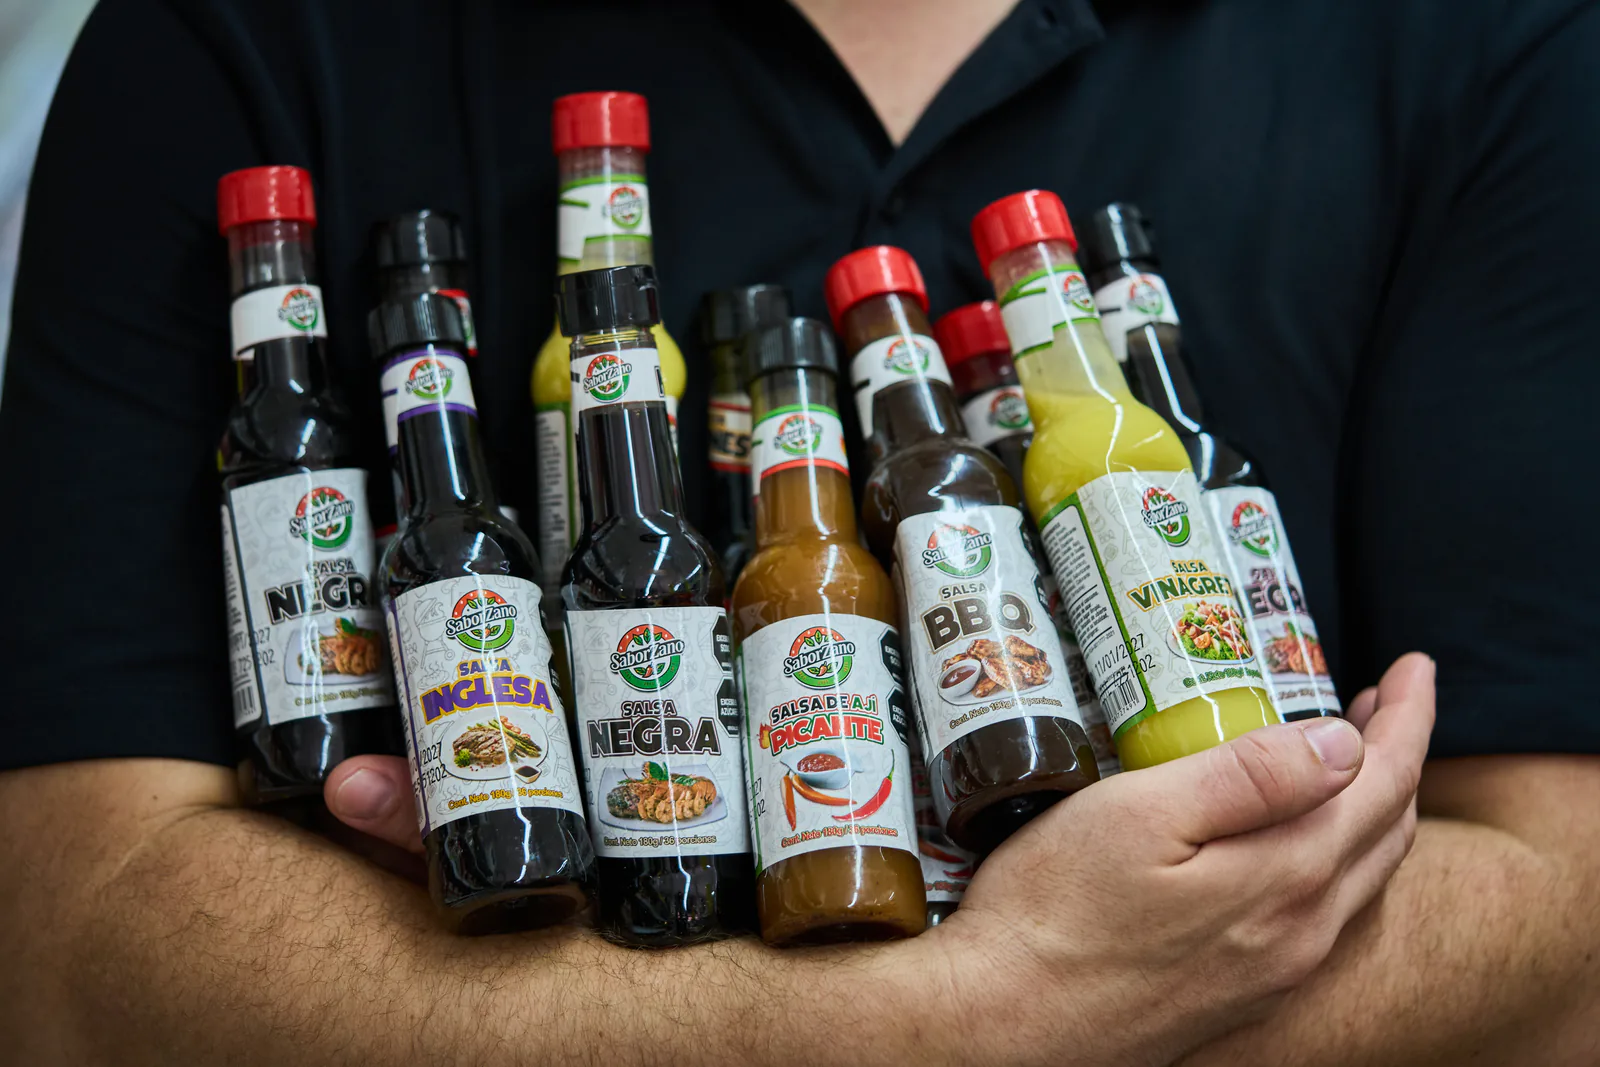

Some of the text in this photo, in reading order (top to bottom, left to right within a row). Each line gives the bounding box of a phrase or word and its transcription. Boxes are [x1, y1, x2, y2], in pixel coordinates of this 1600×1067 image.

[583, 363, 632, 393] SaborZano
[921, 532, 993, 568] Saano
[1171, 560, 1210, 574] SALSA
[941, 583, 987, 599] SALSA
[921, 593, 1036, 653] BBQ
[609, 639, 685, 674] SaborZano
[783, 640, 856, 677] SaborZano
[420, 676, 554, 725] INGLESA
[621, 700, 677, 718] SALSA
[770, 695, 824, 725] SALSA
[824, 694, 850, 710] DE
[587, 715, 721, 758] NEGRA
[769, 712, 884, 756] PICANTE
[663, 836, 676, 846] 36
